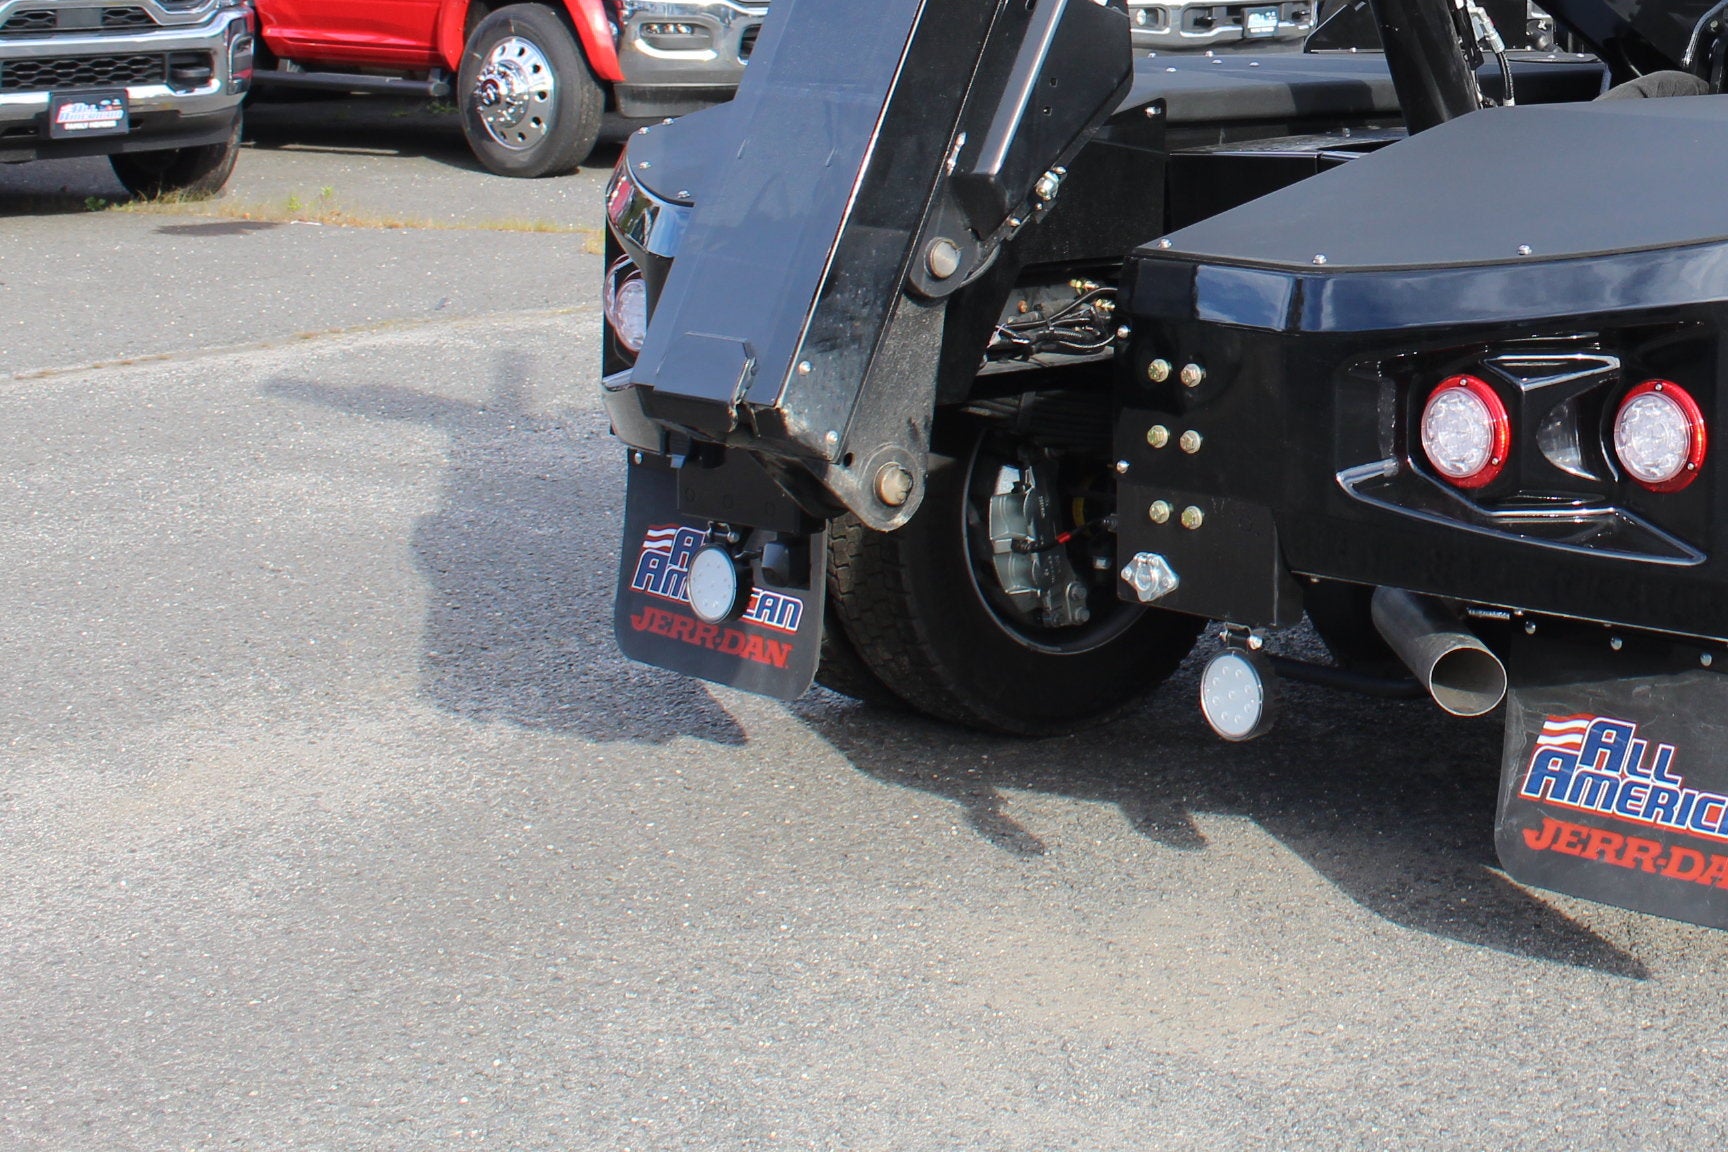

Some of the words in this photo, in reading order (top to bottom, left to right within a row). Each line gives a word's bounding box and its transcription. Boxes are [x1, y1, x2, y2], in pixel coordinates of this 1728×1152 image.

[631, 548, 804, 632] AMAN
[630, 606, 793, 670] JERR-DAN
[1578, 716, 1684, 788] ALL
